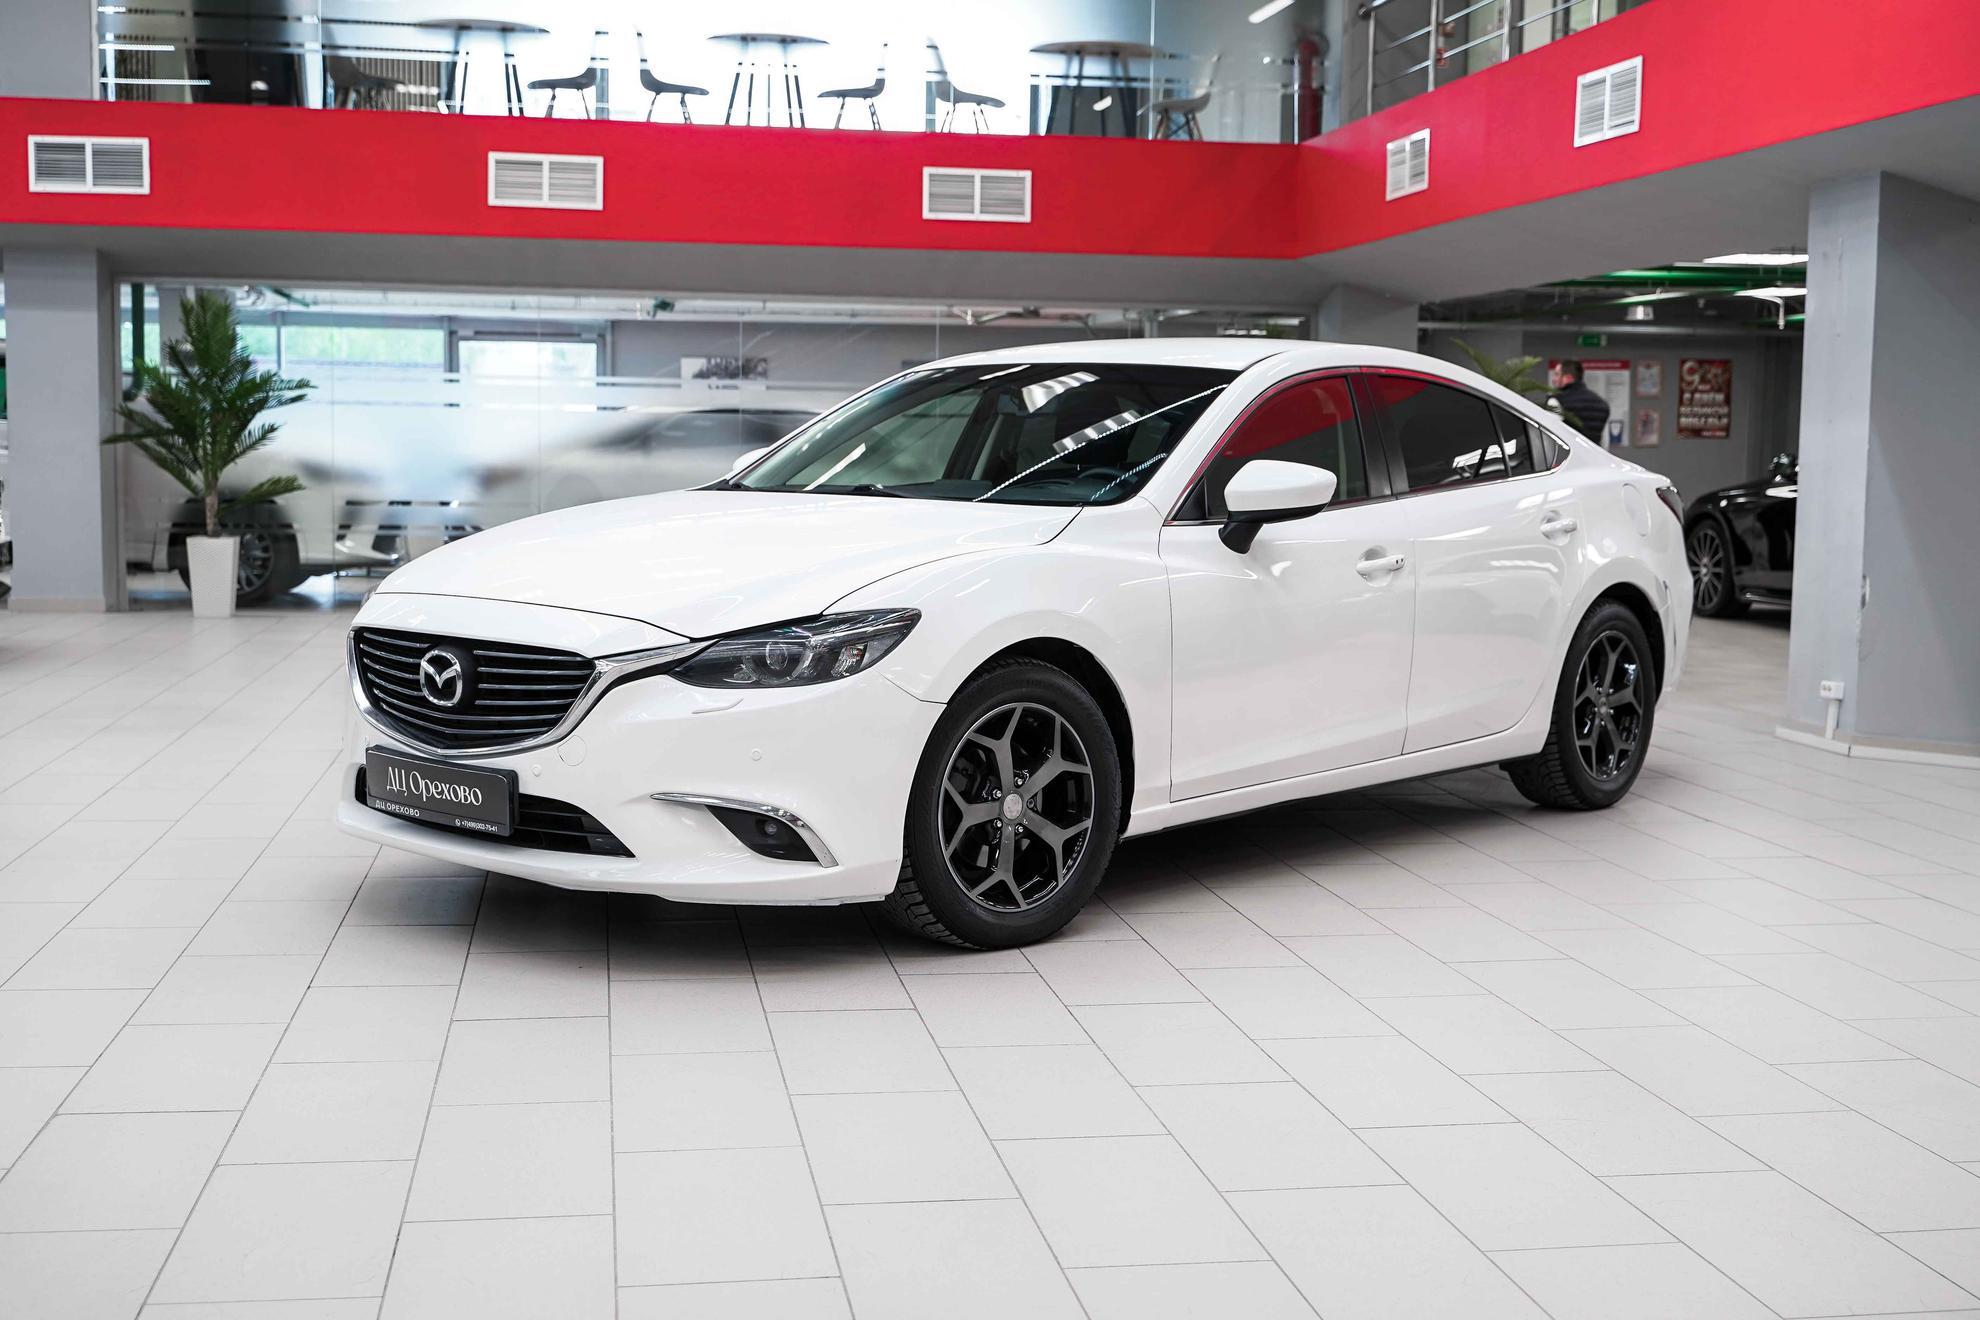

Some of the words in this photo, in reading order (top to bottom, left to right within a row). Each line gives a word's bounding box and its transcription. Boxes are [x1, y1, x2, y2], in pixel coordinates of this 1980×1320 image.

[386, 766, 408, 796] ДЦ
[409, 770, 482, 806] Орехово
[375, 800, 386, 810] ДЦ
[386, 804, 420, 817] ОРЕХОВО
